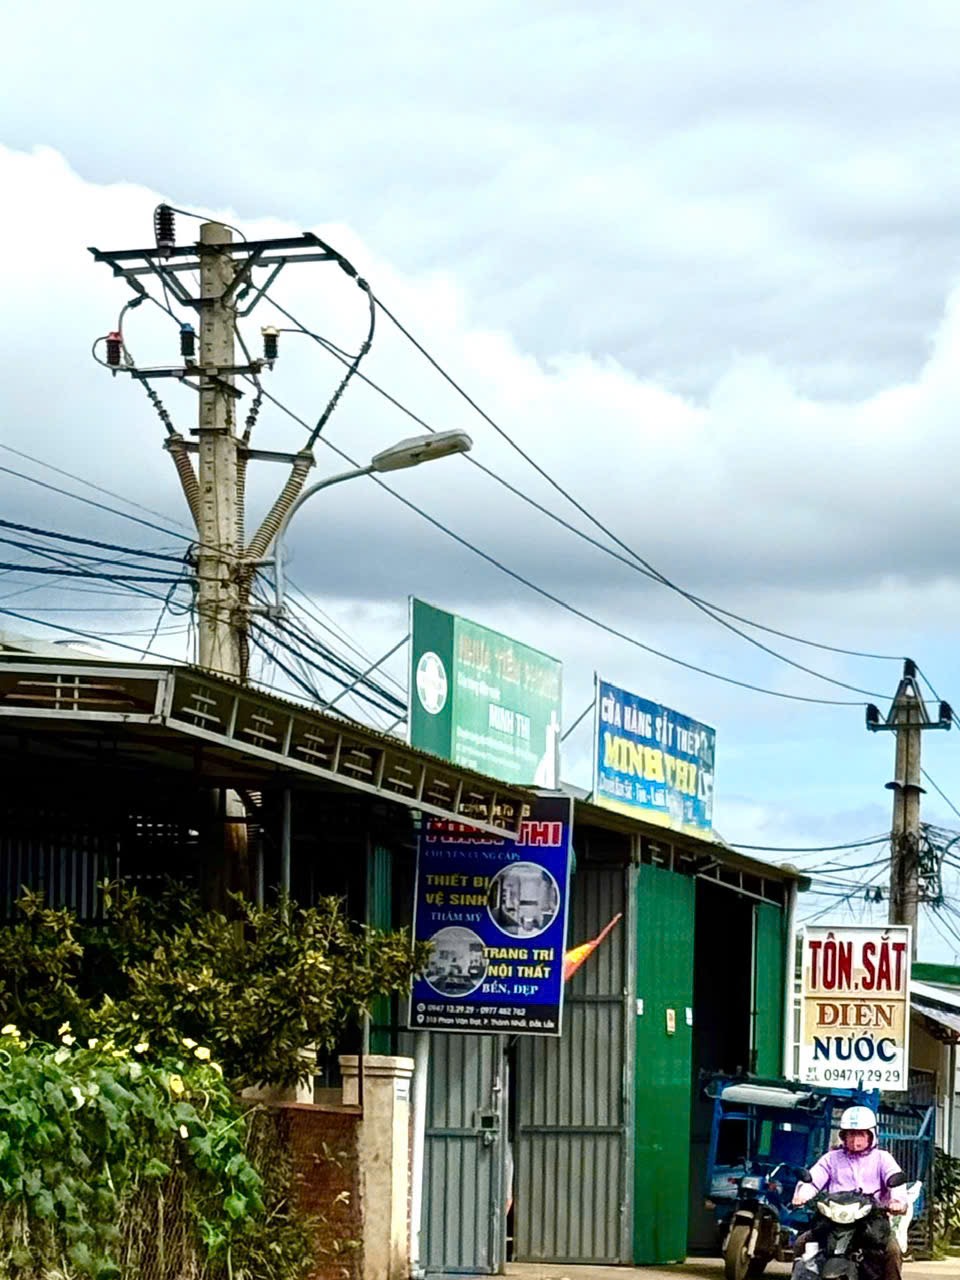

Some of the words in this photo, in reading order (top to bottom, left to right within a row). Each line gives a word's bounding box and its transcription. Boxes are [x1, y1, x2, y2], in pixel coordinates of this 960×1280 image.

[624, 704, 652, 739] HÀNG
[603, 731, 665, 783] MINH
[515, 821, 562, 847] THI
[449, 893, 489, 907] SINH
[482, 947, 528, 960] TRANG
[488, 963, 513, 979] NỘI
[517, 962, 552, 979] THẤT
[812, 1030, 897, 1062] NƯỚC
